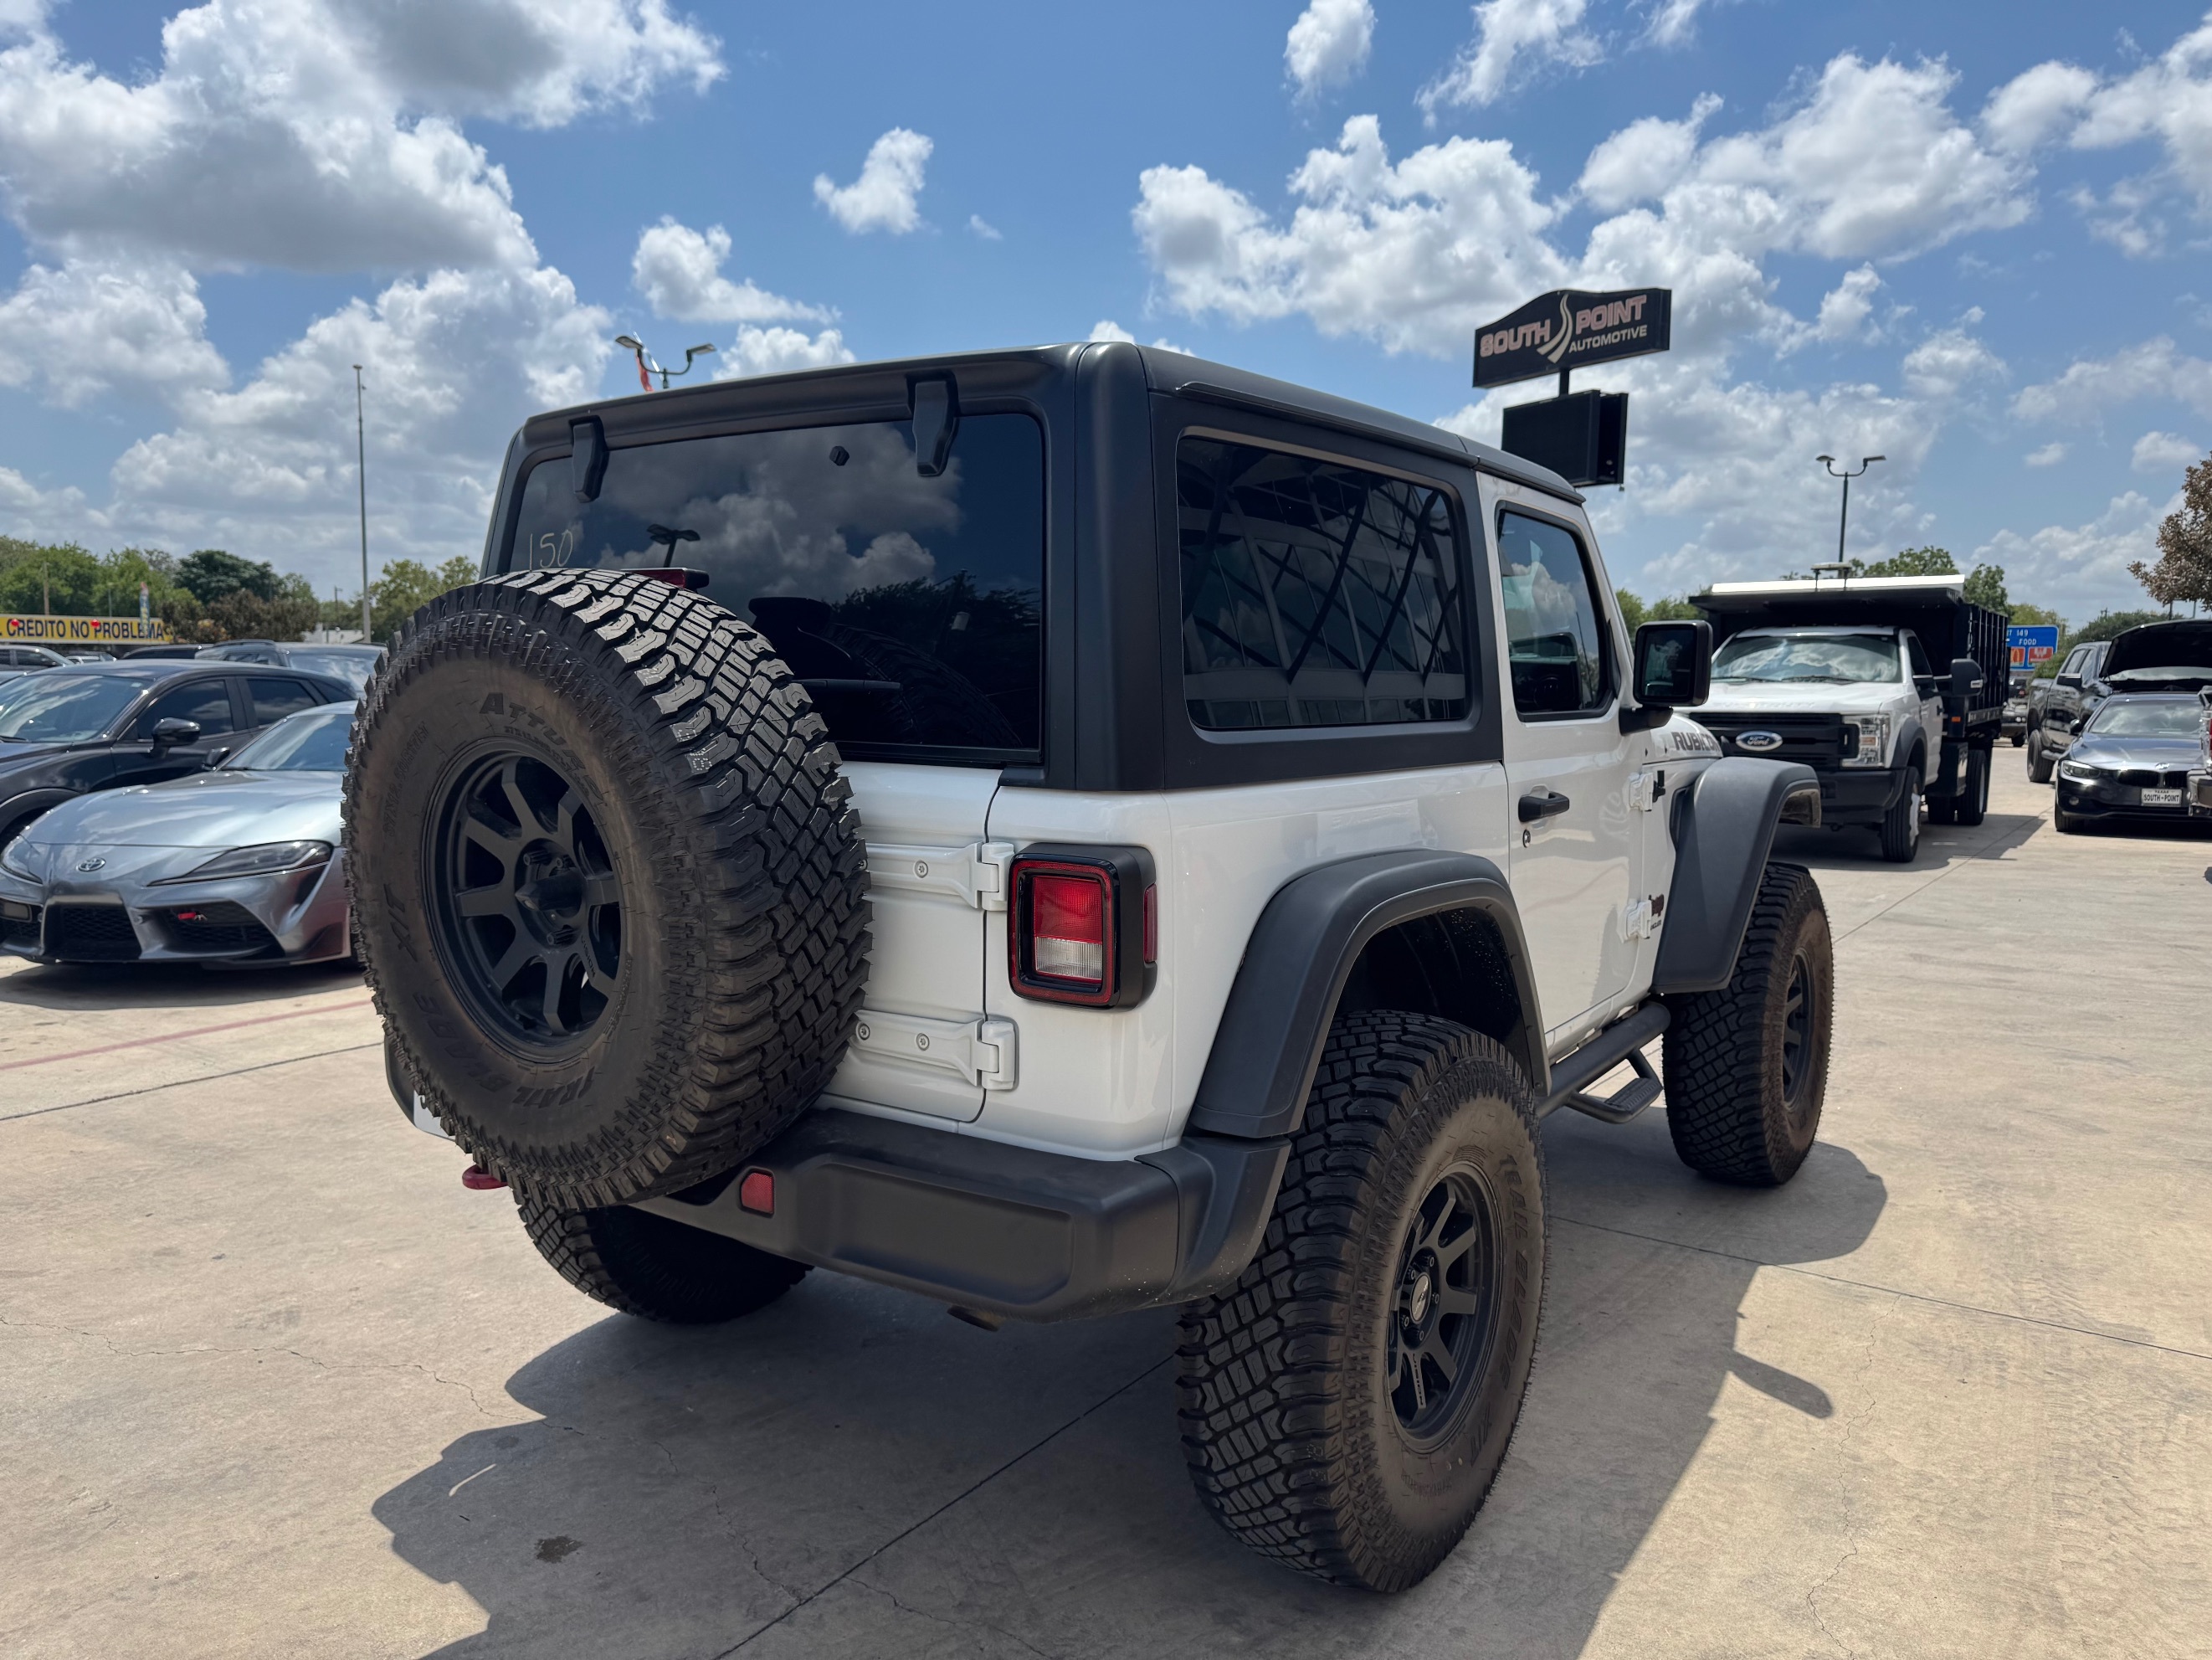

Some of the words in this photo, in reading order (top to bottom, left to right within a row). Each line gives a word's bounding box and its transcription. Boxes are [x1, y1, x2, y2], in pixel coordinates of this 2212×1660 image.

[1480, 319, 1551, 357] SOUTH
[1575, 295, 1647, 335] POINT
[1568, 325, 1648, 353] AUTOMOTIVE
[529, 529, 573, 571] 150
[70, 620, 90, 638] NO
[94, 622, 164, 640] PROBLEMA
[2019, 638, 2037, 646] FOOD
[480, 692, 604, 801] ATTURO
[1747, 735, 1770, 746] Ford
[1499, 1154, 1529, 1240] TRAIL
[1498, 1249, 1529, 1390] BLADE
